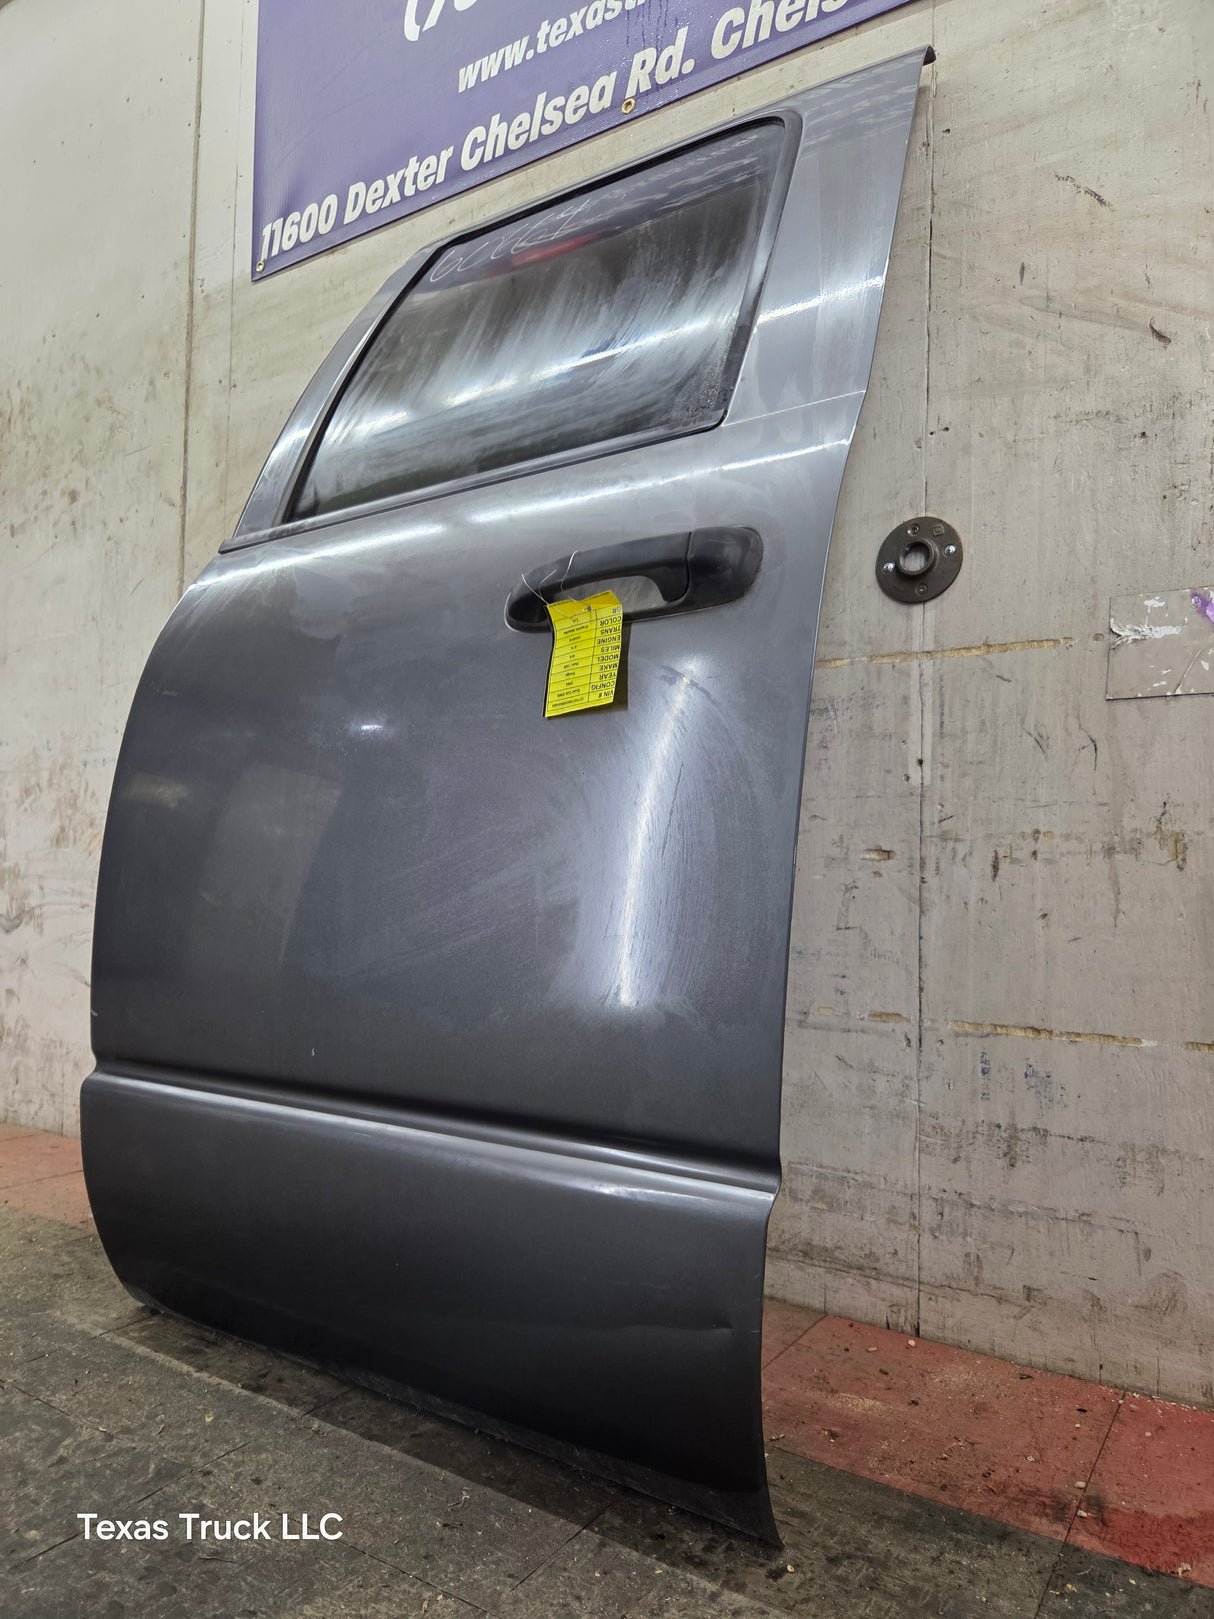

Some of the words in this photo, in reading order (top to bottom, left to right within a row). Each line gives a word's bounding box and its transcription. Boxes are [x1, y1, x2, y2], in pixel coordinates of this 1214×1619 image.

[458, 0, 646, 94] www.texas
[260, 193, 339, 261] 11600
[343, 145, 454, 225] Dexter
[460, 70, 618, 172] Chelsea
[624, 26, 695, 99] Rd.
[600, 615, 622, 626] COLOR
[600, 625, 621, 635] TRANS
[597, 634, 621, 644] ENGINE
[600, 644, 621, 653] MILES
[596, 653, 619, 663] MODEL
[600, 662, 618, 671] MAKE
[599, 671, 617, 680] YEAR
[591, 680, 616, 690] CONFIG
[603, 689, 614, 698] VIN
